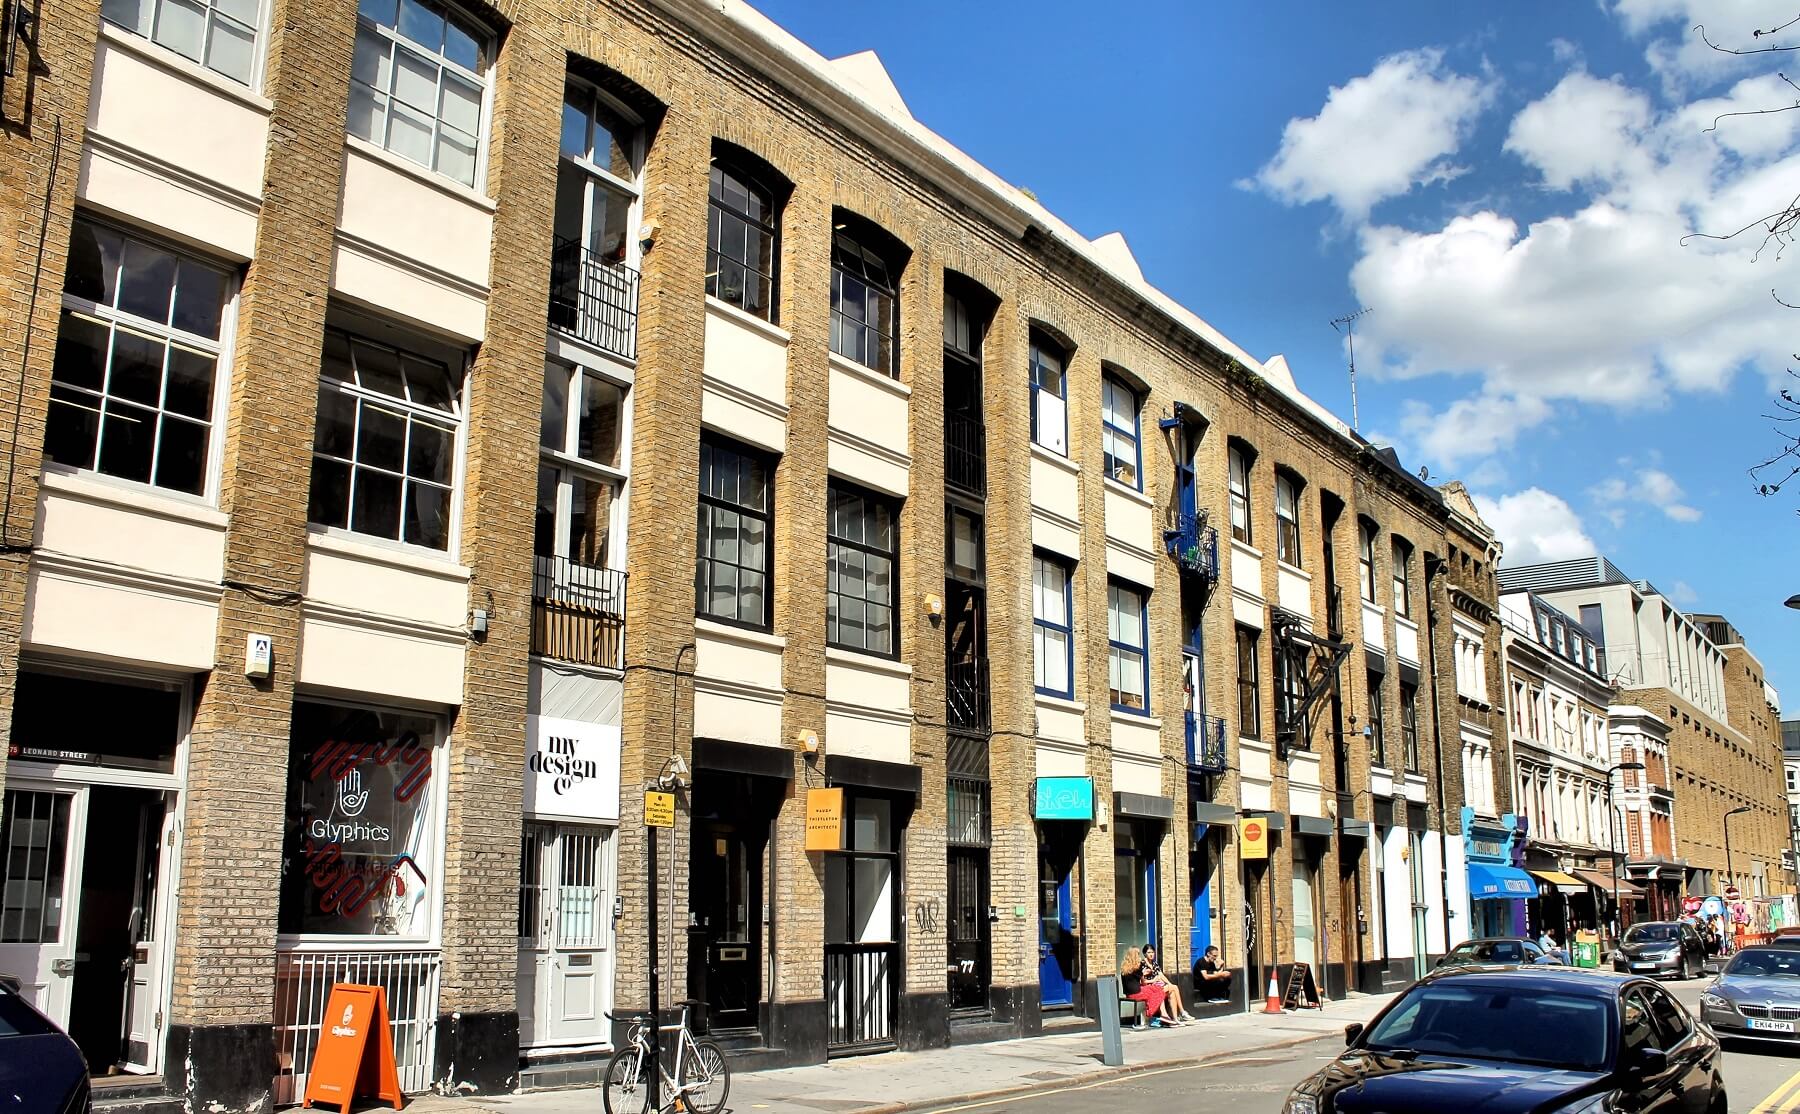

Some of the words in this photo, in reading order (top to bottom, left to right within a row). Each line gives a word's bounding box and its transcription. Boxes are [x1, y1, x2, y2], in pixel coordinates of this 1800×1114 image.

[23, 747, 58, 757] LEONARD
[60, 750, 89, 759] STREET
[548, 735, 580, 758] my
[529, 750, 597, 784] design
[553, 776, 572, 796] co
[311, 819, 390, 844] Glyphics
[960, 960, 975, 974] 77
[1754, 1020, 1773, 1029] EK14
[1774, 1022, 1791, 1031] HPA
